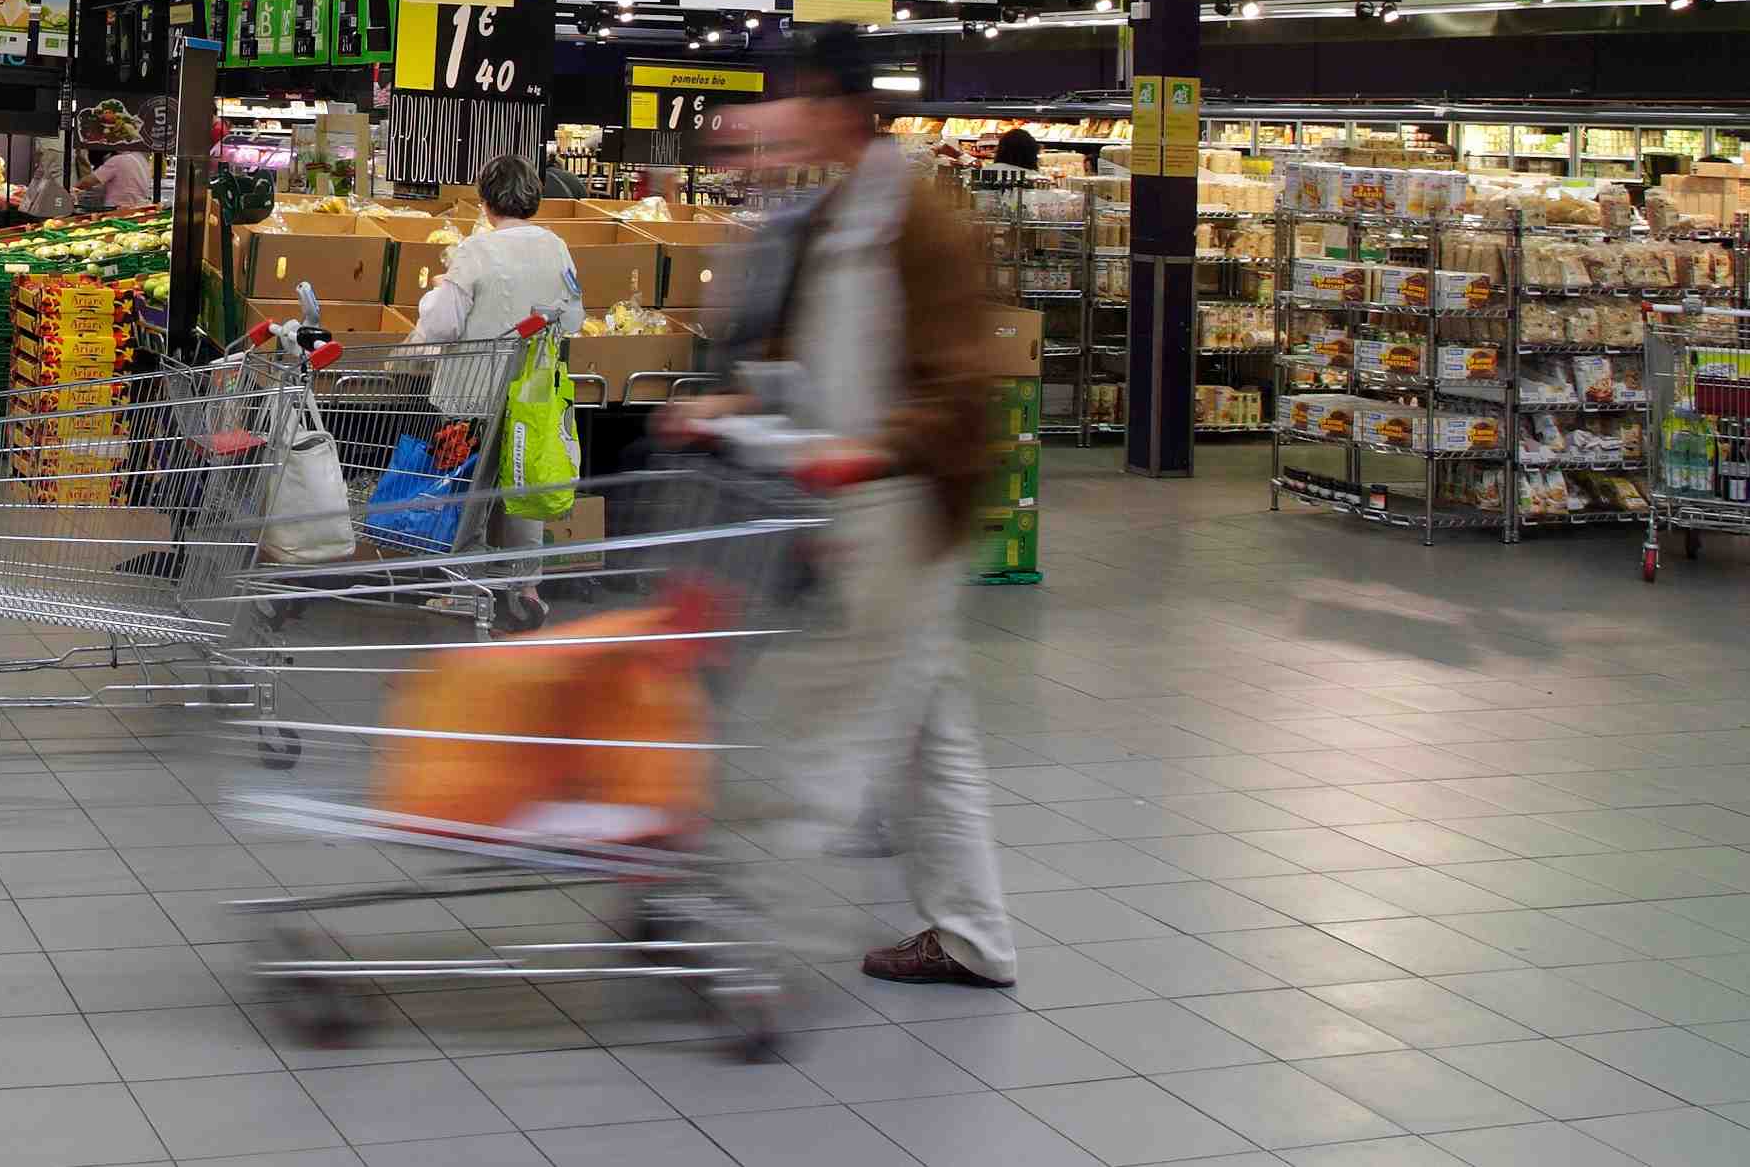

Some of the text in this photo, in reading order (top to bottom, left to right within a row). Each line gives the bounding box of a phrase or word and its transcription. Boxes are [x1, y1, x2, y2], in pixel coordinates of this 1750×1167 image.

[670, 73, 726, 85] pomelos bio
[387, 93, 465, 185] REPUBLIQUE
[650, 131, 683, 164] FRANCE
